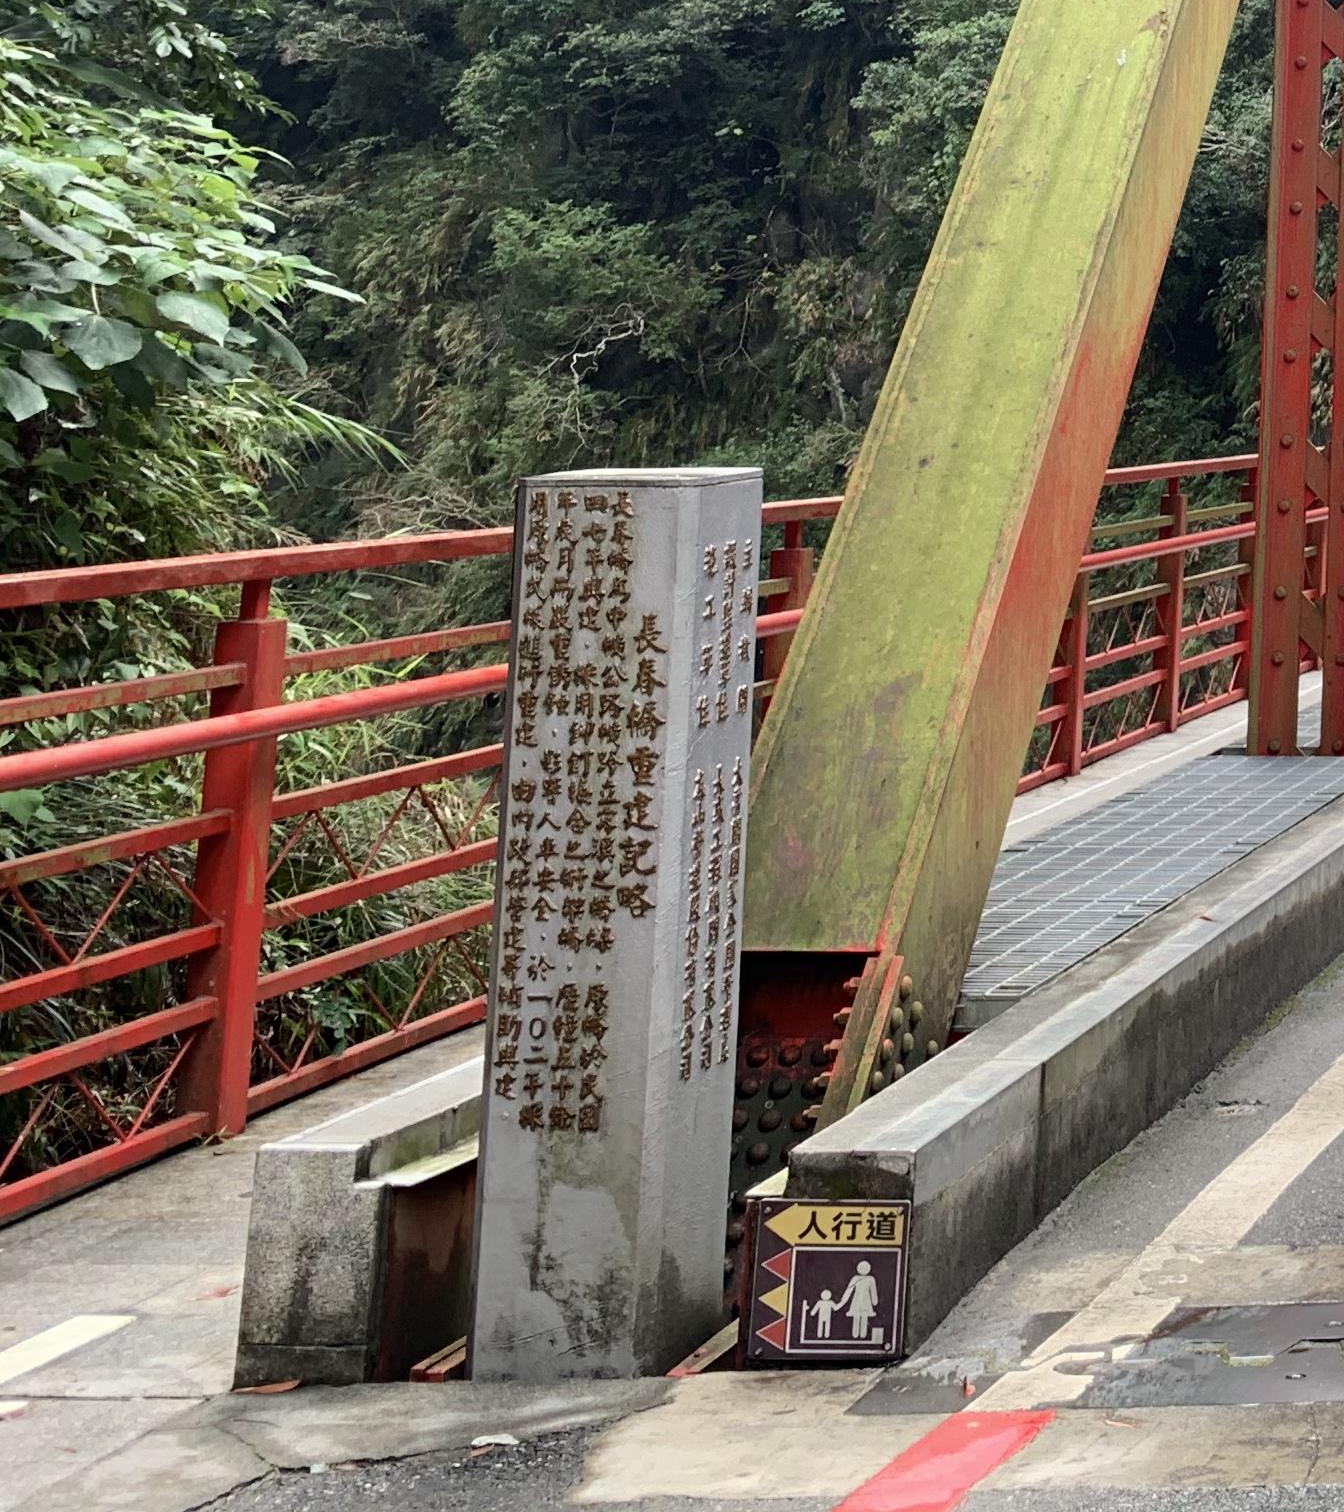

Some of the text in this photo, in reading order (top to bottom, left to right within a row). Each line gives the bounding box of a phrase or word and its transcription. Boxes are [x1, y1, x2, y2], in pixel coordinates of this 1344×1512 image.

[617, 613, 667, 920] 長春橋重建記略
[798, 1210, 898, 1241] 人行道
